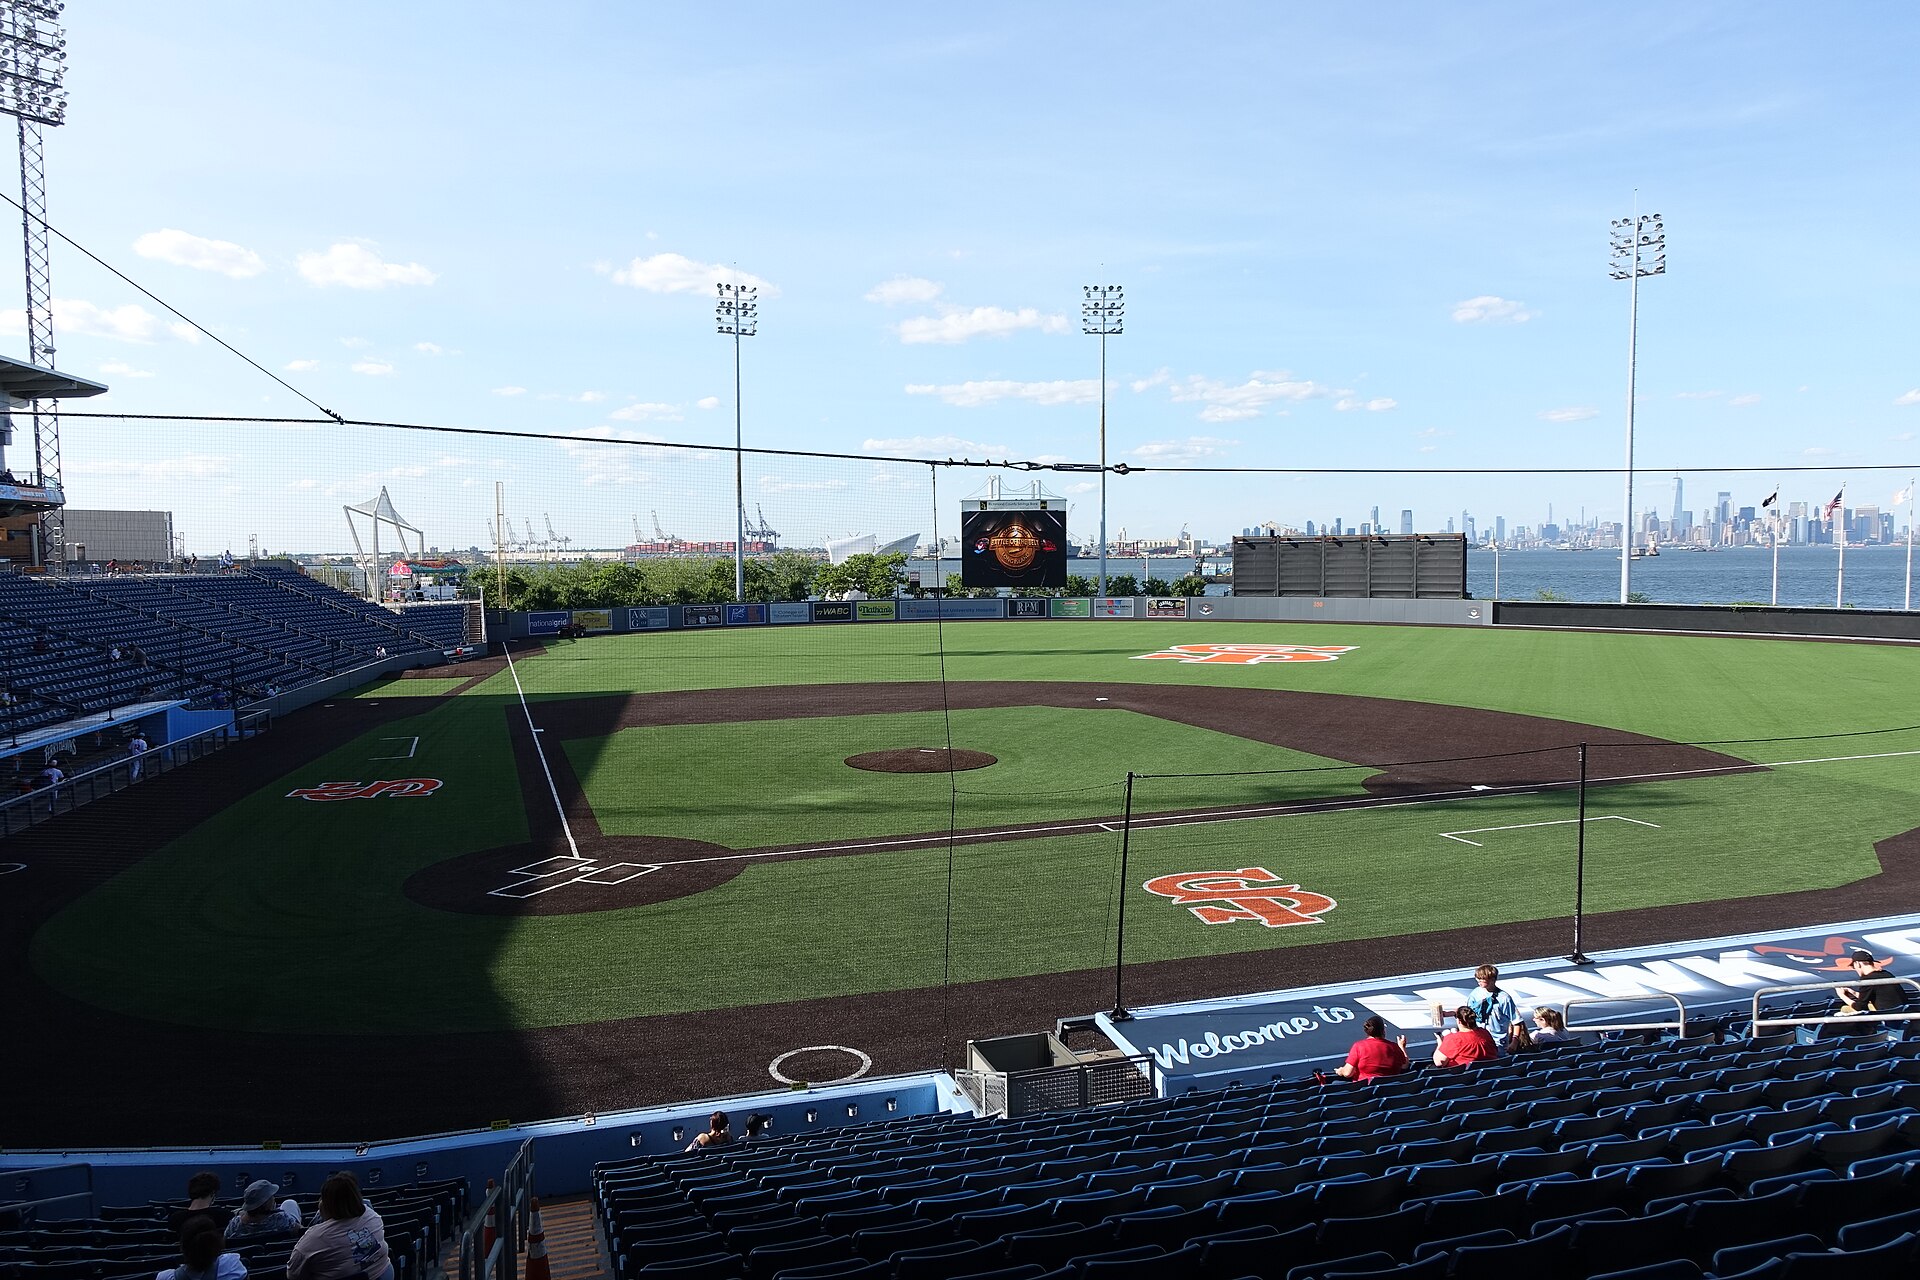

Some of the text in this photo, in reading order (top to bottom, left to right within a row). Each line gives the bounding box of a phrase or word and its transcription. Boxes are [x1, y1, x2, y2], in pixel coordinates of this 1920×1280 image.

[1018, 601, 1038, 611] RPM
[631, 610, 639, 619] A
[639, 610, 647, 619] &
[823, 607, 849, 616] WABC
[1147, 1016, 1319, 1069] Welcome
[1312, 1005, 1355, 1024] to
